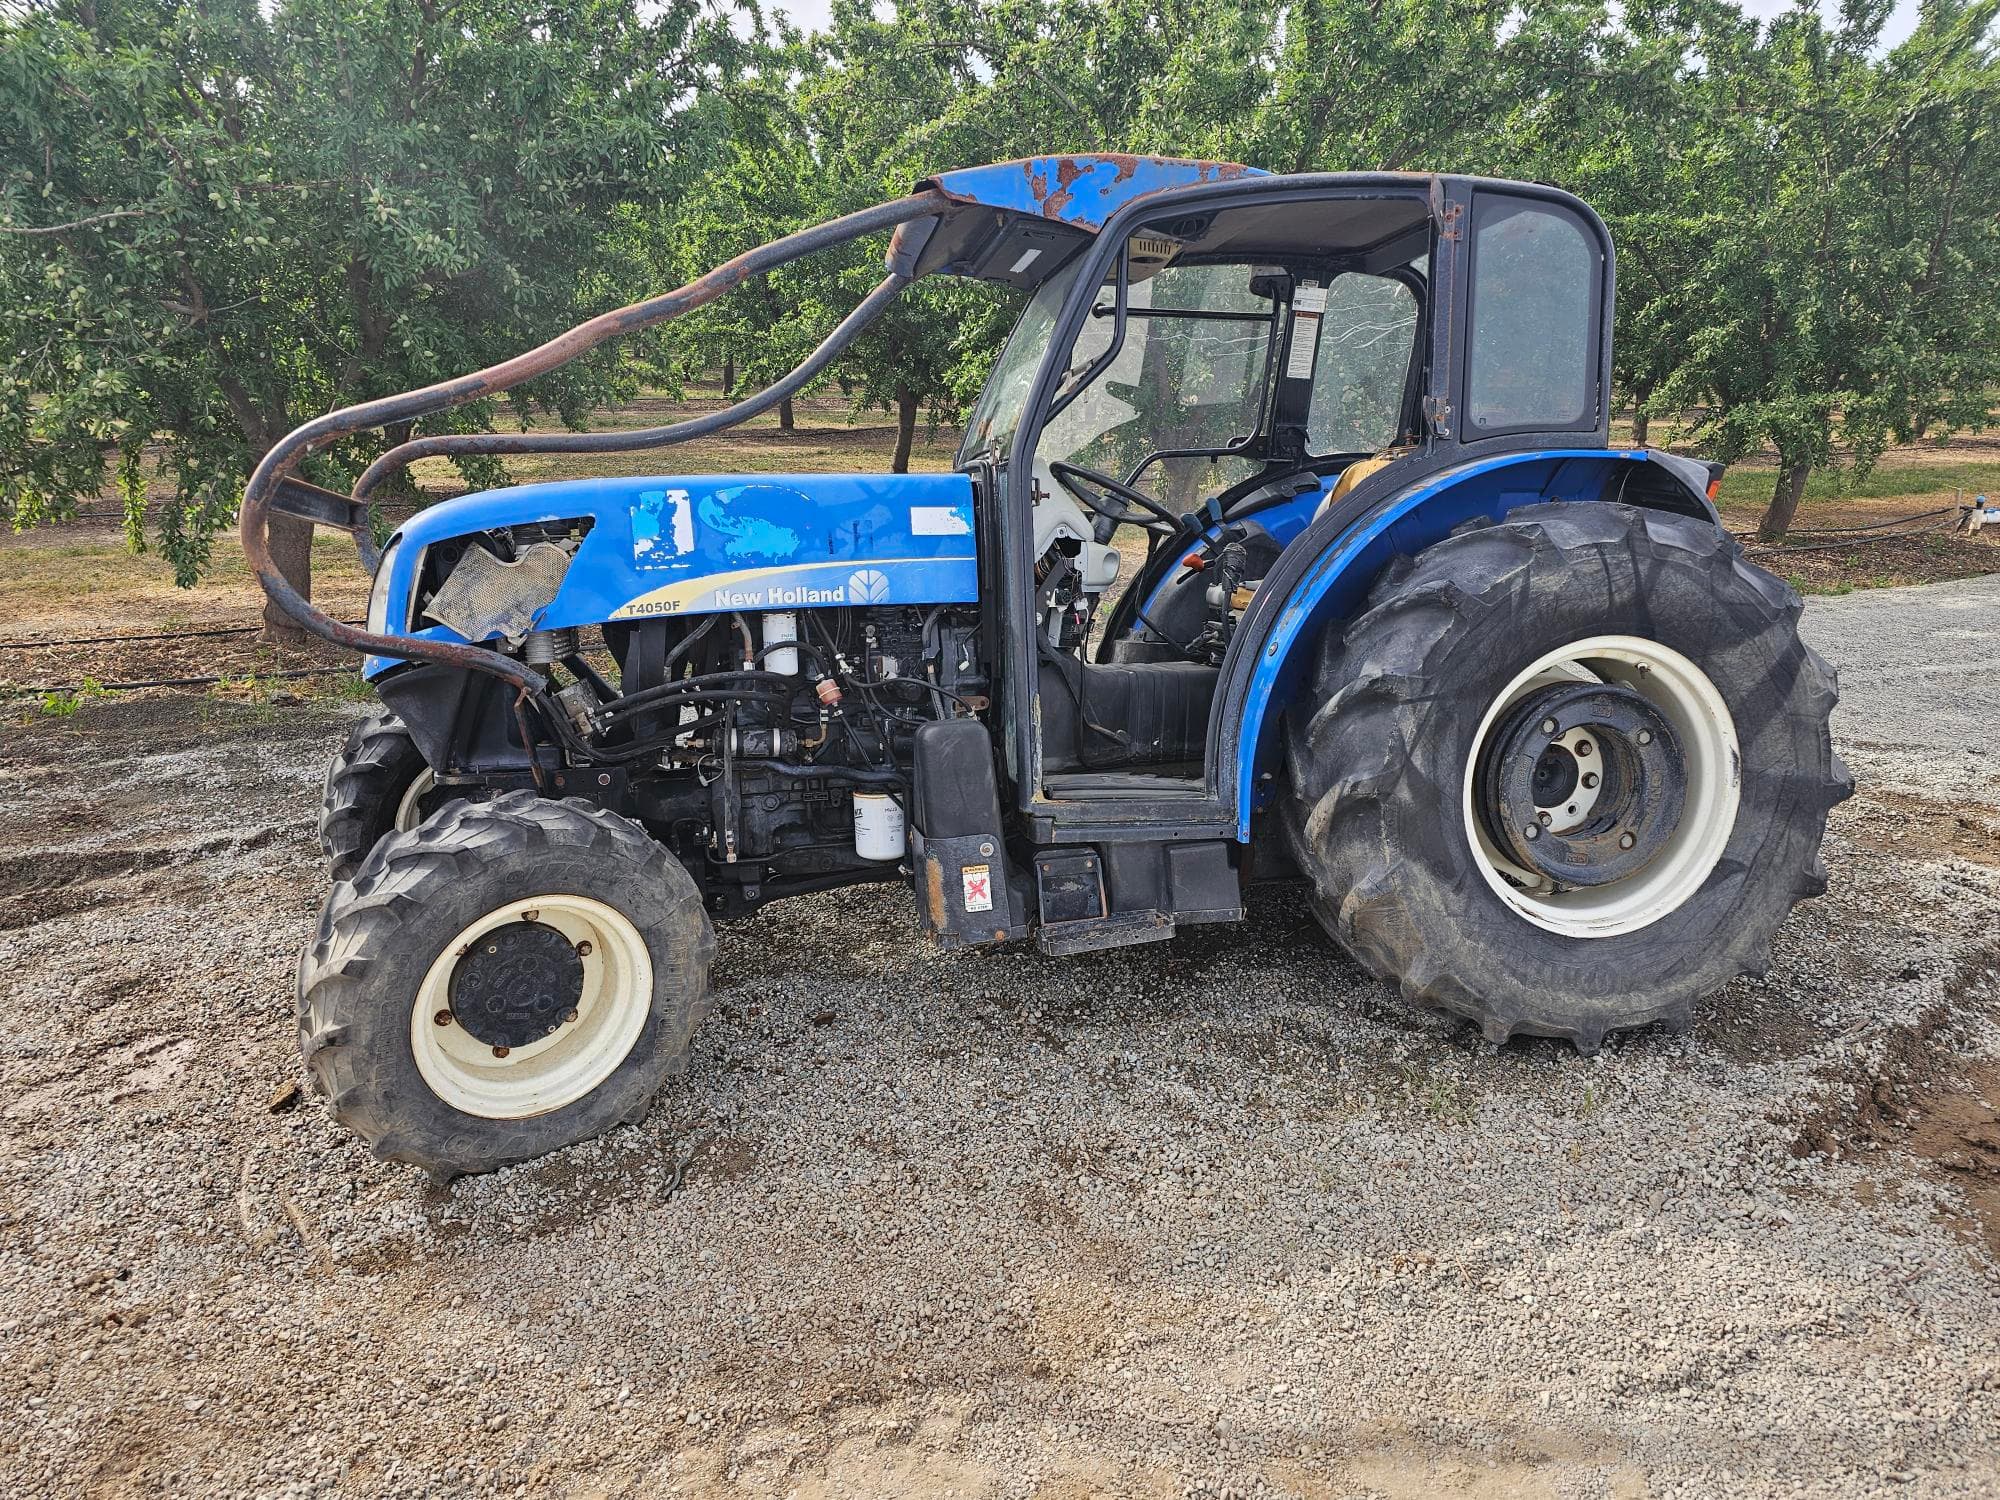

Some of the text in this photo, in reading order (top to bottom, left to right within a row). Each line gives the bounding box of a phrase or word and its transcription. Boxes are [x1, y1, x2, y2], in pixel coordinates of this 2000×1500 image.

[715, 586, 845, 607] New Holland
[626, 600, 681, 615] T4050F
